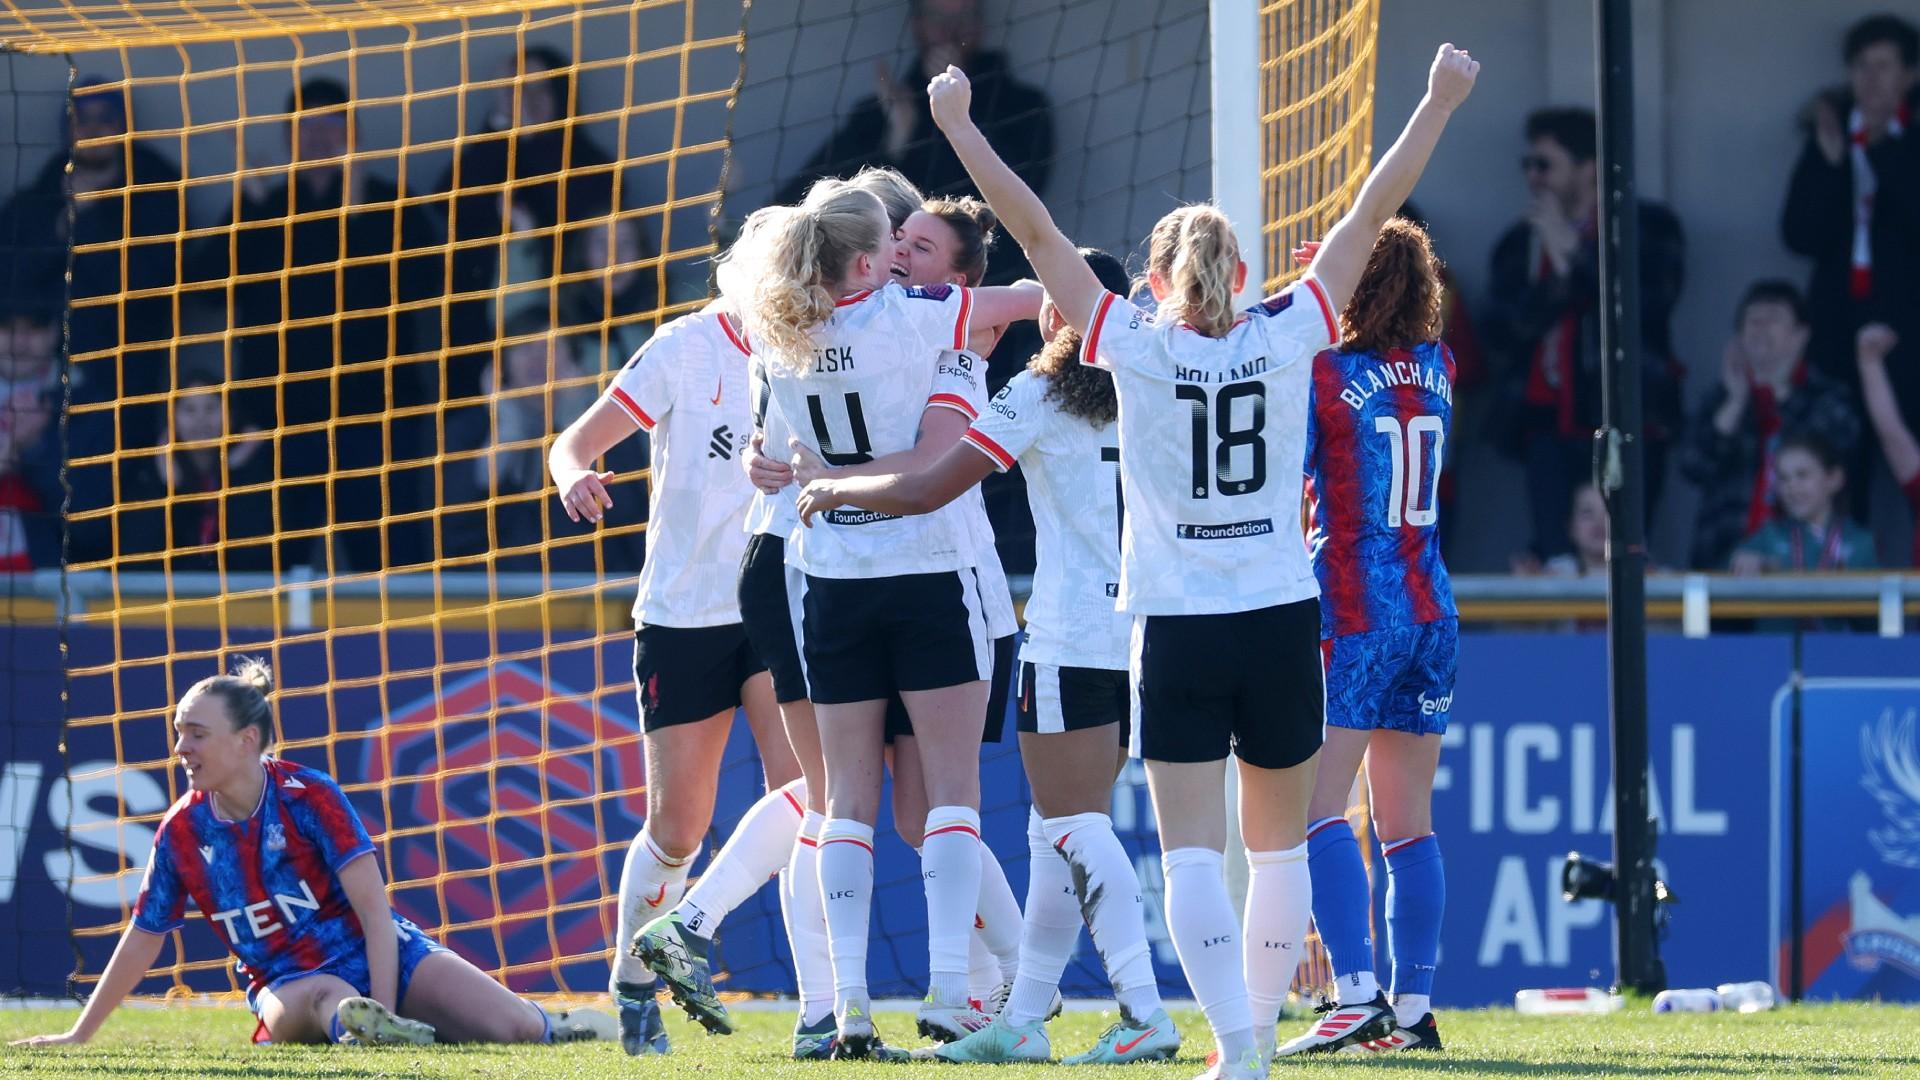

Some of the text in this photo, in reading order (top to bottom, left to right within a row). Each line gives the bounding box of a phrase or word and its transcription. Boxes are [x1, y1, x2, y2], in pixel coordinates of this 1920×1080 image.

[813, 346, 855, 373] ISK
[990, 401, 1017, 420] edia
[806, 391, 875, 467] 4
[1175, 380, 1267, 500] 18
[1374, 415, 1445, 528] 10
[833, 511, 895, 524] Foundati
[1193, 522, 1270, 538] Foundation
[924, 870, 937, 880] FC
[829, 889, 855, 901] LFC
[210, 878, 321, 945] TEN
[1477, 855, 1670, 968] AP
[1203, 935, 1232, 949] LFC
[1264, 940, 1292, 950] LFC
